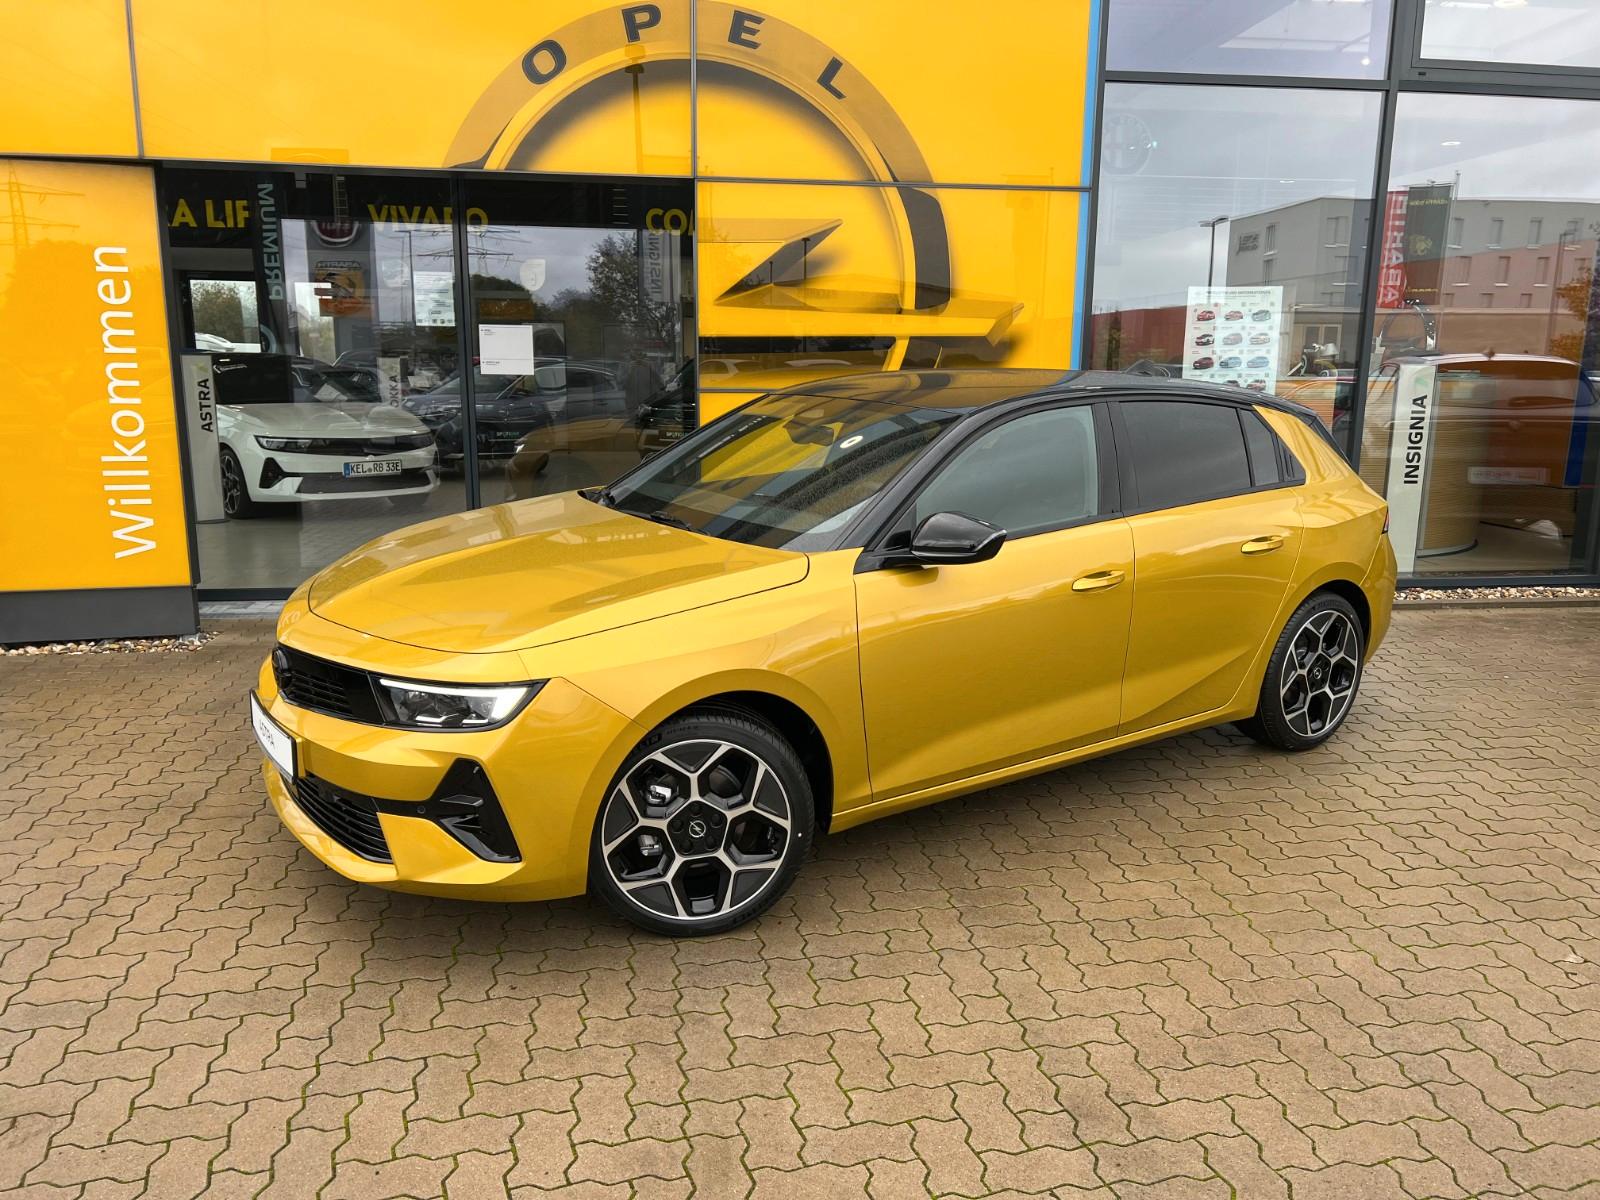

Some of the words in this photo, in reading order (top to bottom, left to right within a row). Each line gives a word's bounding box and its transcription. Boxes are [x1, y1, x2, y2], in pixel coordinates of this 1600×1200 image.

[522, 4, 847, 100] OPEL
[168, 199, 198, 227] A
[205, 199, 250, 228] LIF
[94, 246, 156, 559] Willkommen
[197, 378, 213, 433] ASTRA
[389, 374, 400, 408] OKKA
[1403, 394, 1428, 485] INSIGNIA
[351, 463, 367, 474] KEL
[385, 461, 401, 472] 33E
